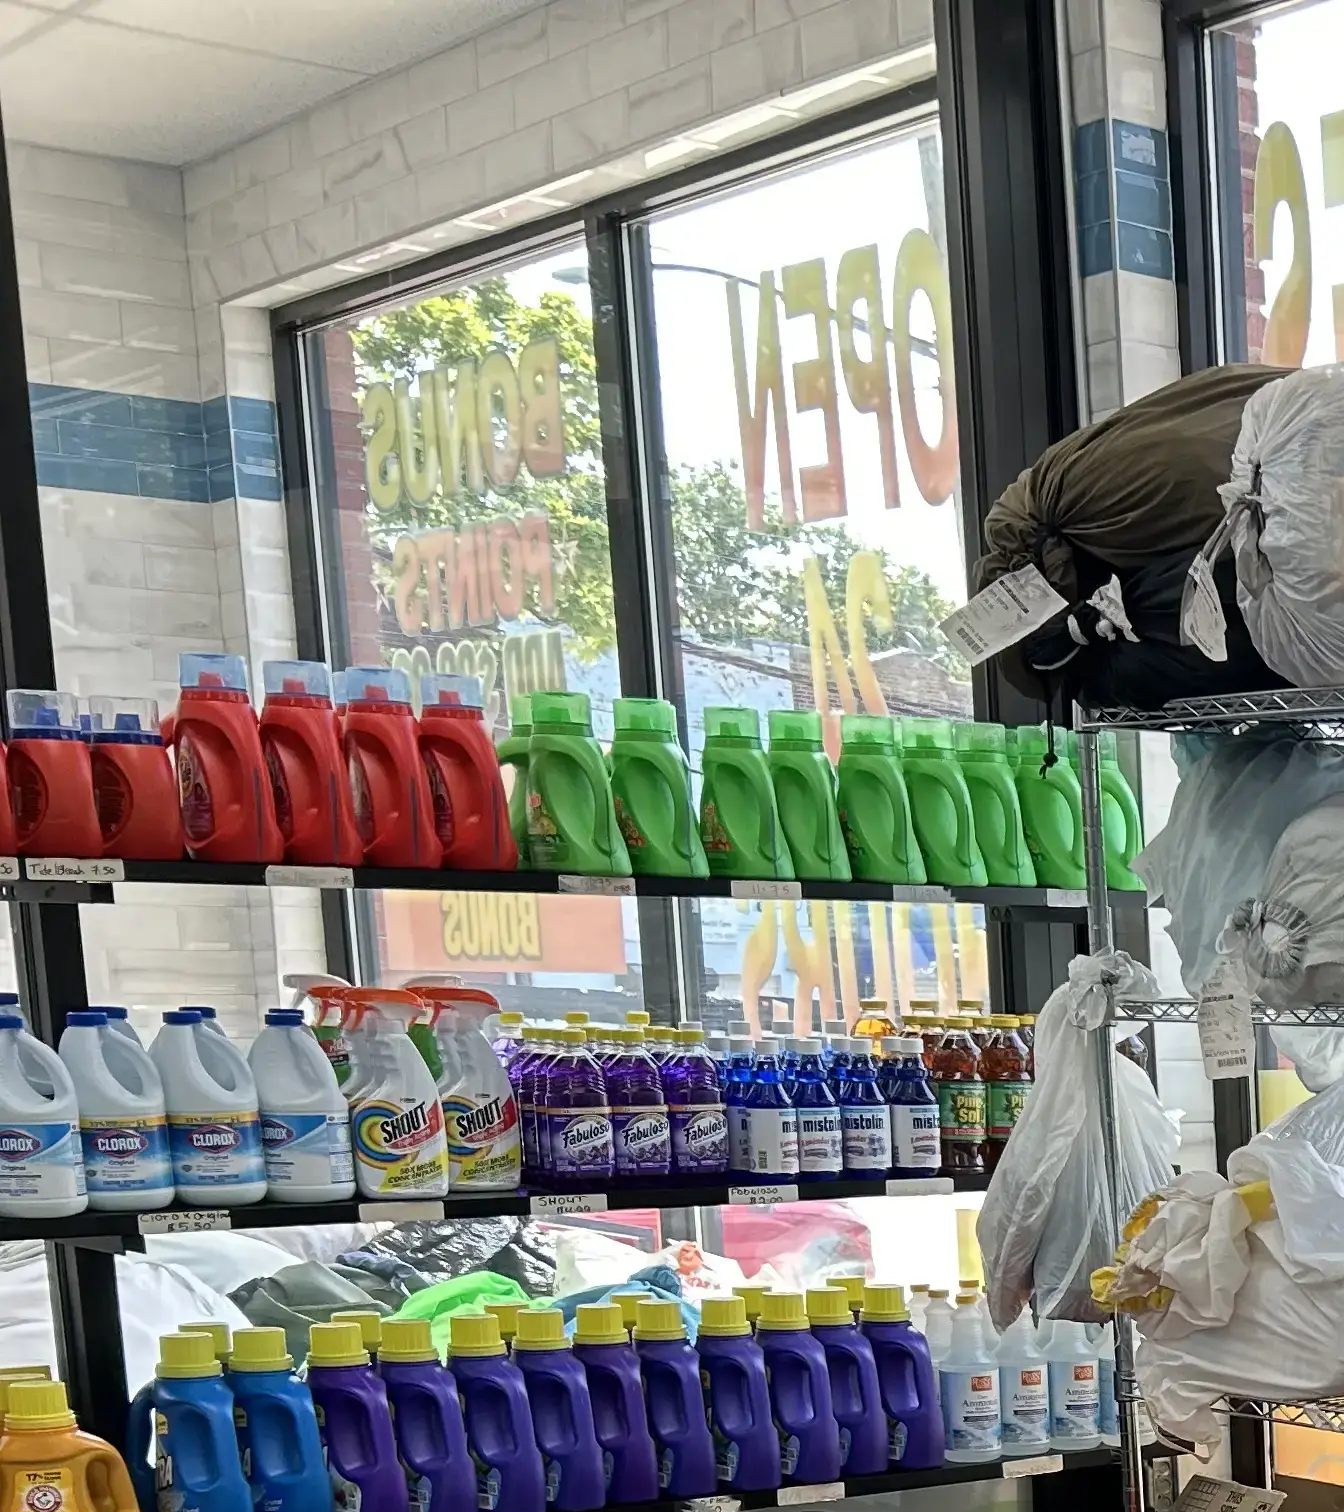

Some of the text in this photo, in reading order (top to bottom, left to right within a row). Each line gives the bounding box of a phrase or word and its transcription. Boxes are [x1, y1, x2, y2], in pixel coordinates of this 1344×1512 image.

[380, 1101, 428, 1144] SHOUT
[456, 1098, 502, 1138] SHOUT
[192, 1132, 236, 1148] CLOROX
[560, 1119, 611, 1150] Fabuloso
[621, 1118, 670, 1149] Fabuloso
[682, 1117, 728, 1145] Fabuloso
[0, 1136, 34, 1152] LOROX
[97, 1136, 141, 1152] CLOROX
[537, 1195, 589, 1207] SHOUT
[1225, 1489, 1246, 1505] THIS
